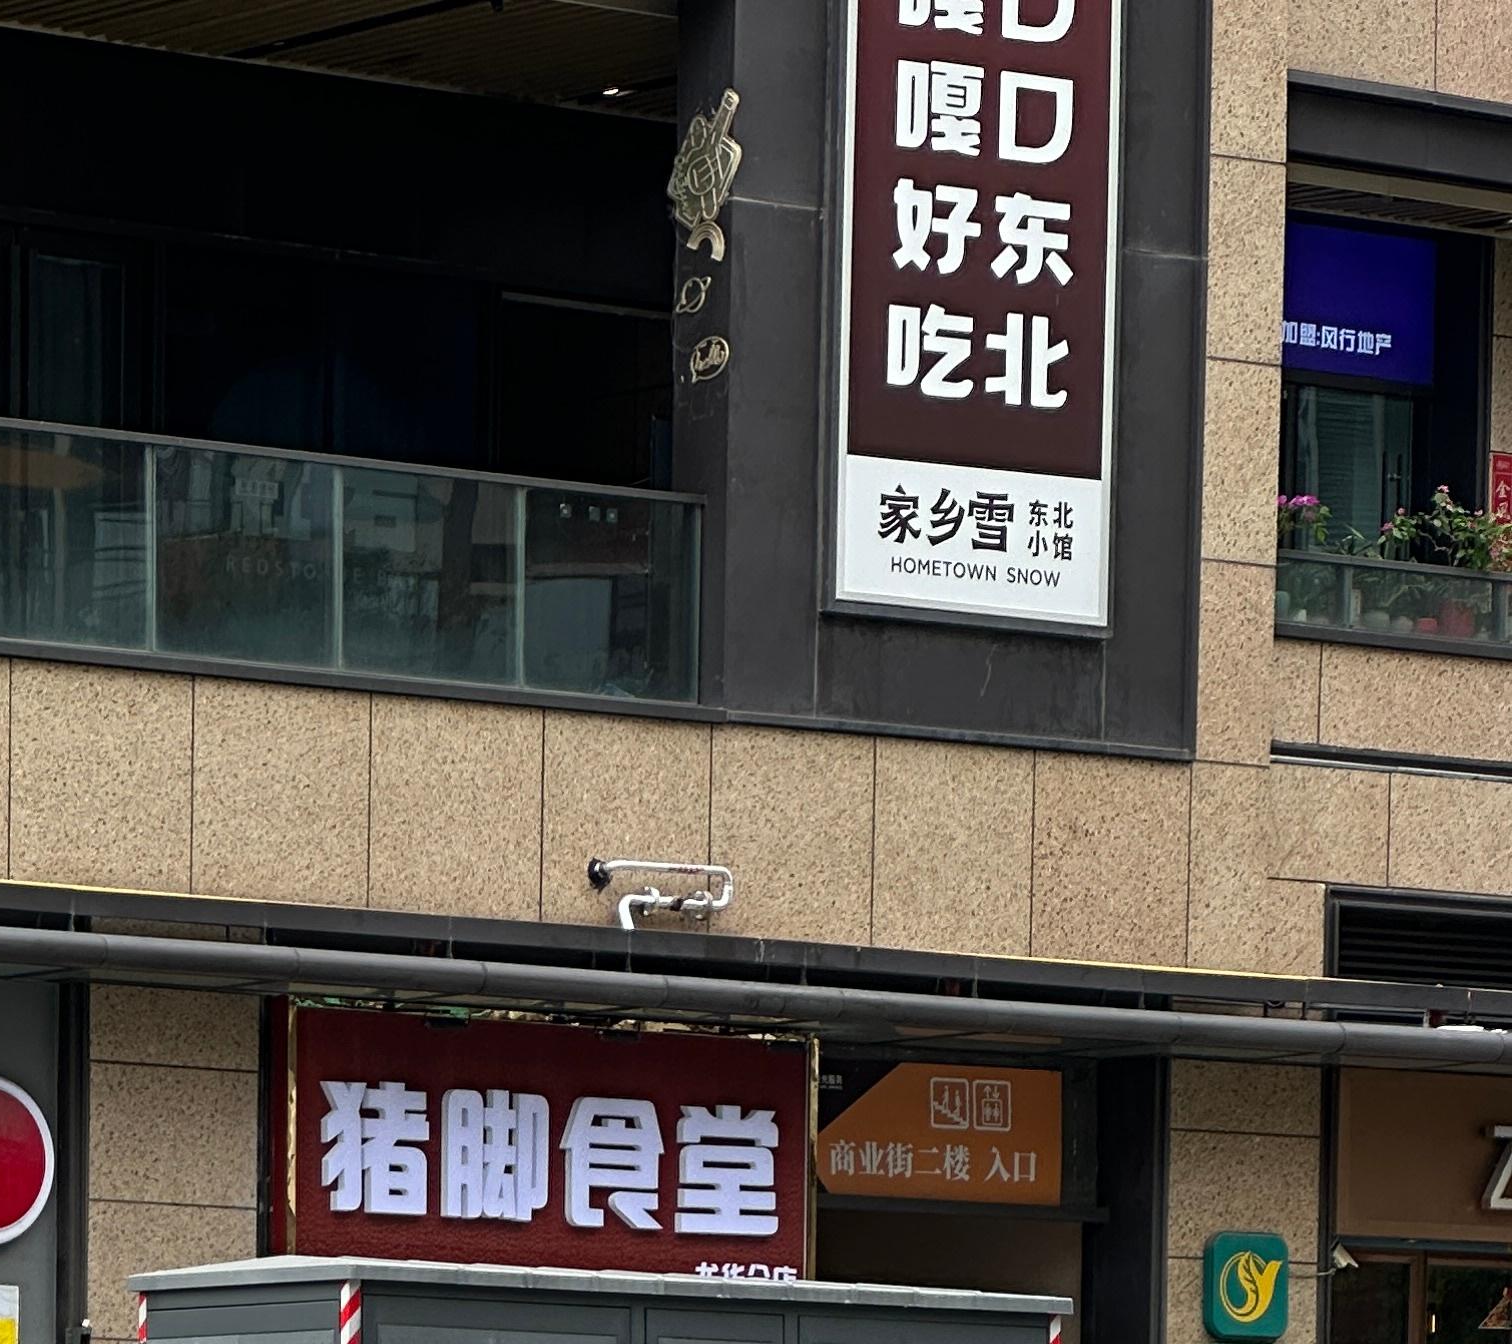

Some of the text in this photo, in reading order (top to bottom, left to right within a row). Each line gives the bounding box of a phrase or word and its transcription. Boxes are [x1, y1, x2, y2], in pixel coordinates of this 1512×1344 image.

[877, 482, 1073, 552] 家乡雪 东北
[1027, 530, 1073, 561] 小馆
[891, 556, 1061, 588] HOMETOWN SNOW
[319, 1080, 780, 1238] 猪脚食堂
[829, 1139, 1037, 1183] 商业街二楼 入口
